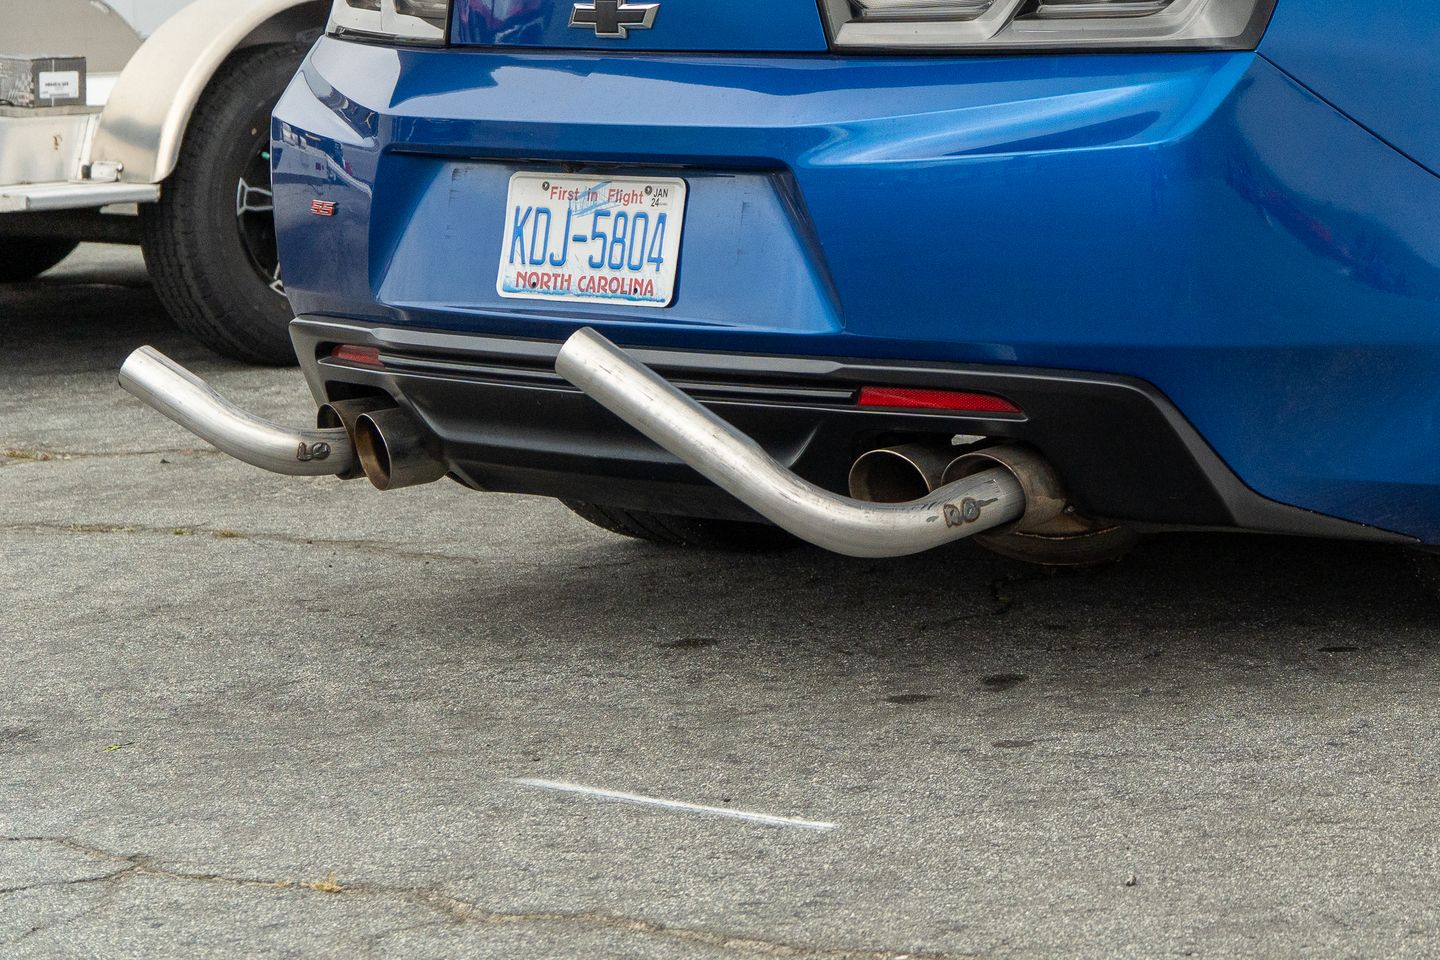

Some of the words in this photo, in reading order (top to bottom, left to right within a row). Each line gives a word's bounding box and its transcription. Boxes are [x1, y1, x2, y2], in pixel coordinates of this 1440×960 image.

[550, 186, 579, 201] First
[587, 187, 598, 202] in
[607, 188, 644, 207] Flight
[653, 188, 669, 198] JAN
[310, 199, 336, 216] SS
[509, 206, 668, 272] KDJ-5804
[515, 271, 572, 291] NORTH
[578, 275, 655, 297] CAROLINA
